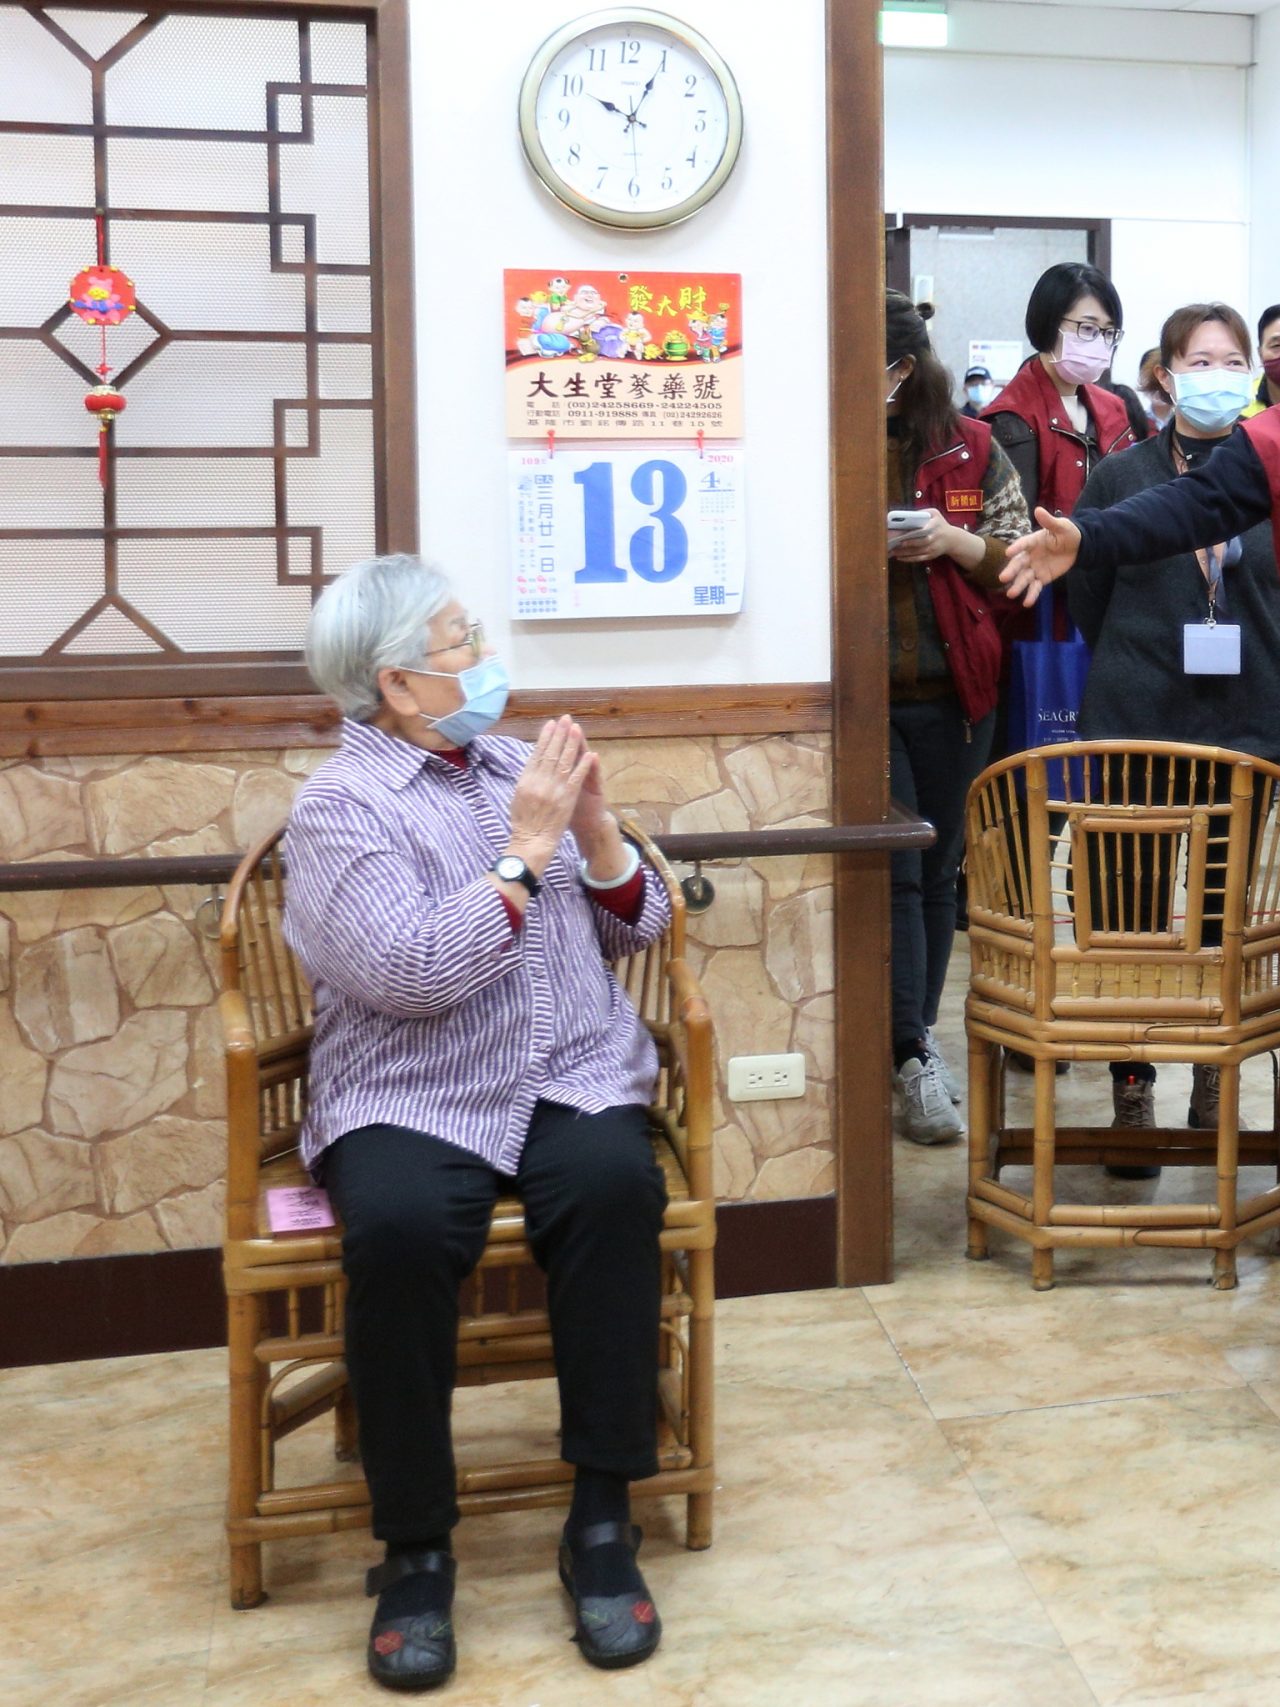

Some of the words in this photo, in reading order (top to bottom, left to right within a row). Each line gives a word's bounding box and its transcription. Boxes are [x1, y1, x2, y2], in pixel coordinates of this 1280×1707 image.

[589, 49, 606, 71] 11
[620, 41, 641, 64] 12
[660, 50, 668, 72] 1
[562, 74, 583, 97] 10
[684, 75, 697, 97] 2
[558, 109, 570, 130] 9
[694, 110, 706, 133] 3
[568, 143, 581, 166] 8
[686, 145, 697, 168] 4
[596, 166, 608, 189] 7
[628, 176, 640, 197] 6
[661, 167, 673, 190] 5
[629, 285, 707, 317] 發大財
[707, 454, 734, 463] 2020
[701, 471, 720, 489] 4
[573, 459, 689, 584] 13
[693, 585, 740, 606] 星期一
[1038, 708, 1079, 723] SEAGR
